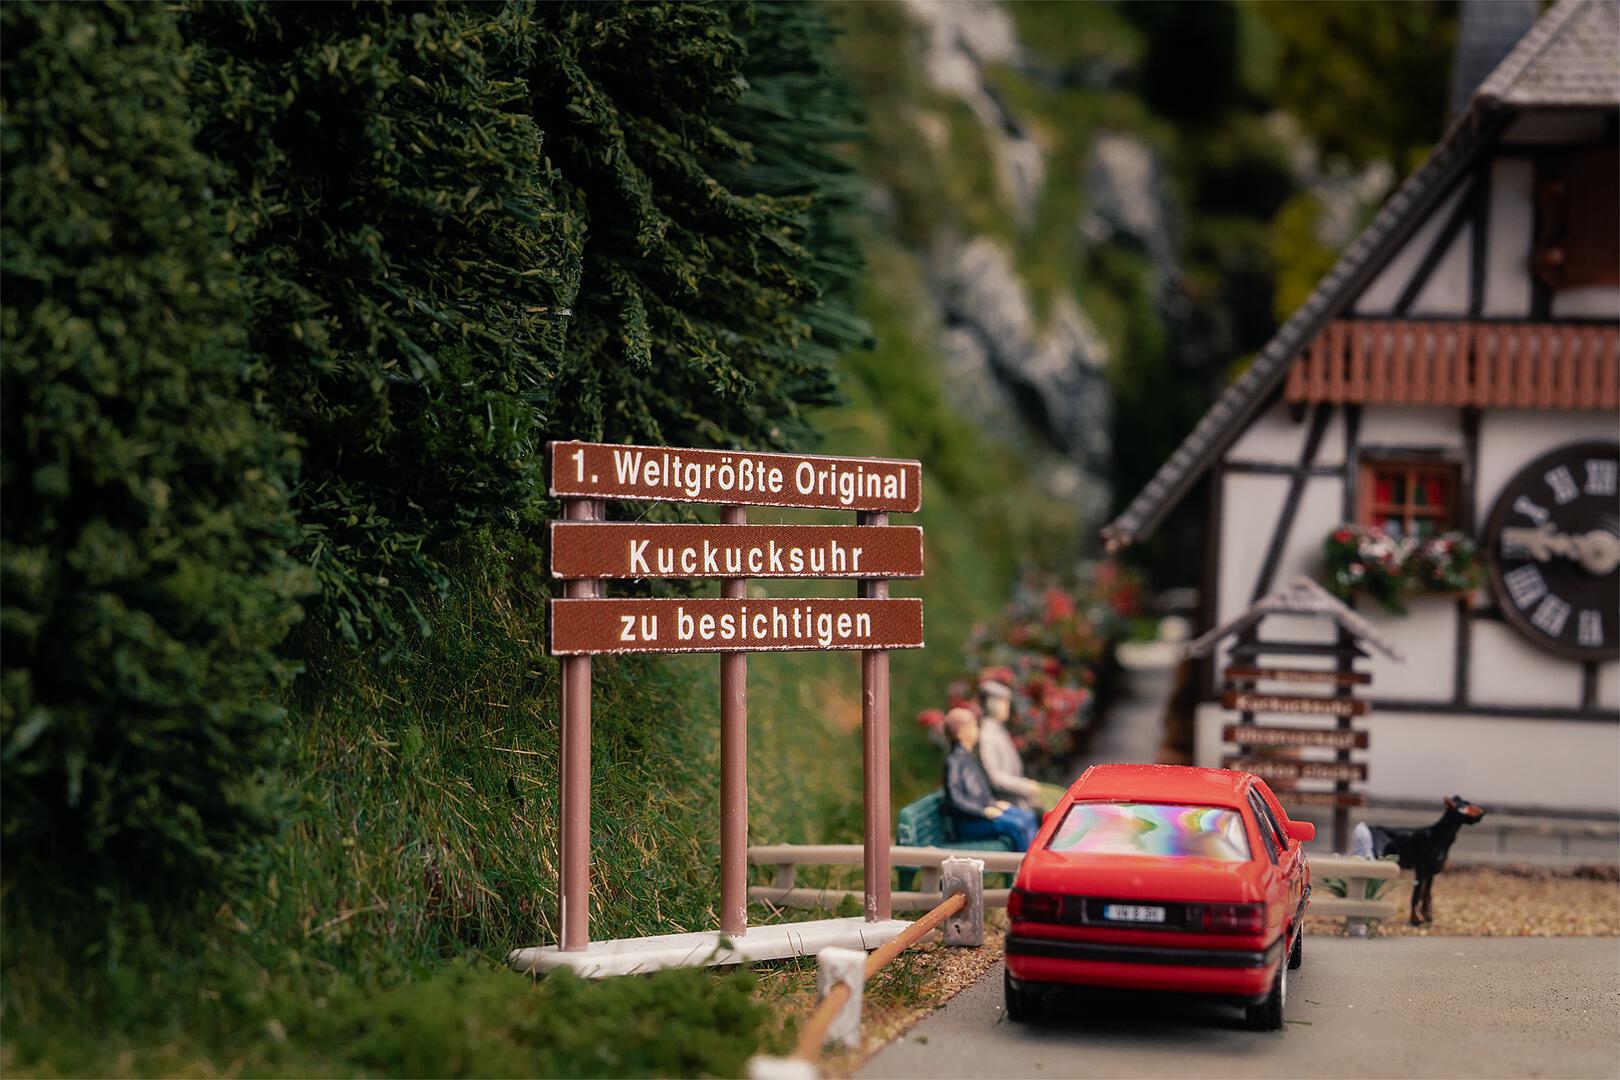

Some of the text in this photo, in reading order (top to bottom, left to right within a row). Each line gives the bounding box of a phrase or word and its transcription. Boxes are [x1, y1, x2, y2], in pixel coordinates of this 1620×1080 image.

[571, 448, 907, 505] 1. Weltgrößte Original
[629, 539, 863, 574] Kuckucksuhr
[620, 606, 871, 646] zu besichtigen
